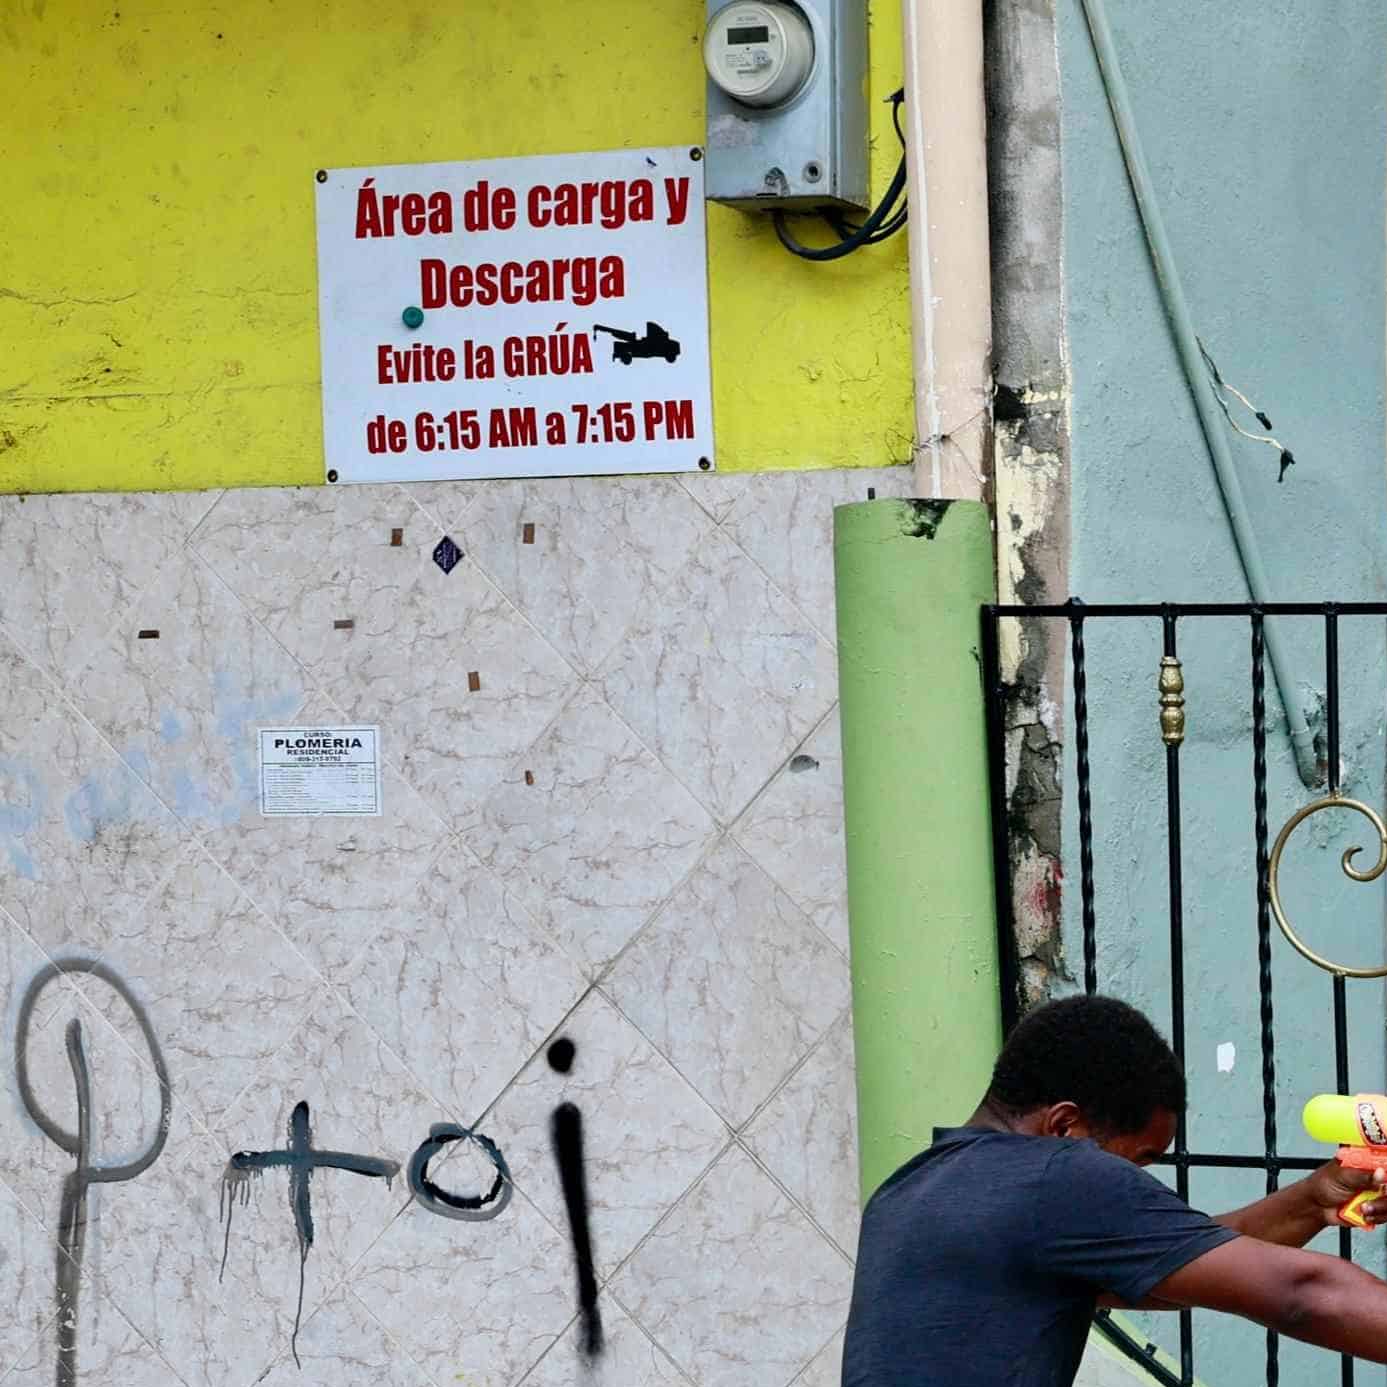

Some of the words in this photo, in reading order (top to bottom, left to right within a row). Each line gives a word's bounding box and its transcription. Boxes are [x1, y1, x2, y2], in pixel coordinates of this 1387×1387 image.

[355, 178, 453, 239] Área
[463, 180, 516, 232] de
[527, 178, 654, 230] carga
[664, 177, 690, 225] y
[420, 255, 625, 310] Descarga
[377, 344, 456, 385] Evite
[464, 340, 495, 380] la
[503, 322, 594, 378] GRÚA
[366, 415, 408, 454] de
[416, 410, 481, 452] 6:15
[489, 407, 538, 448] AM
[546, 411, 567, 445] a
[571, 401, 636, 444] 7:15
[644, 400, 695, 441] PM
[274, 738, 362, 749] PLOMERIA
